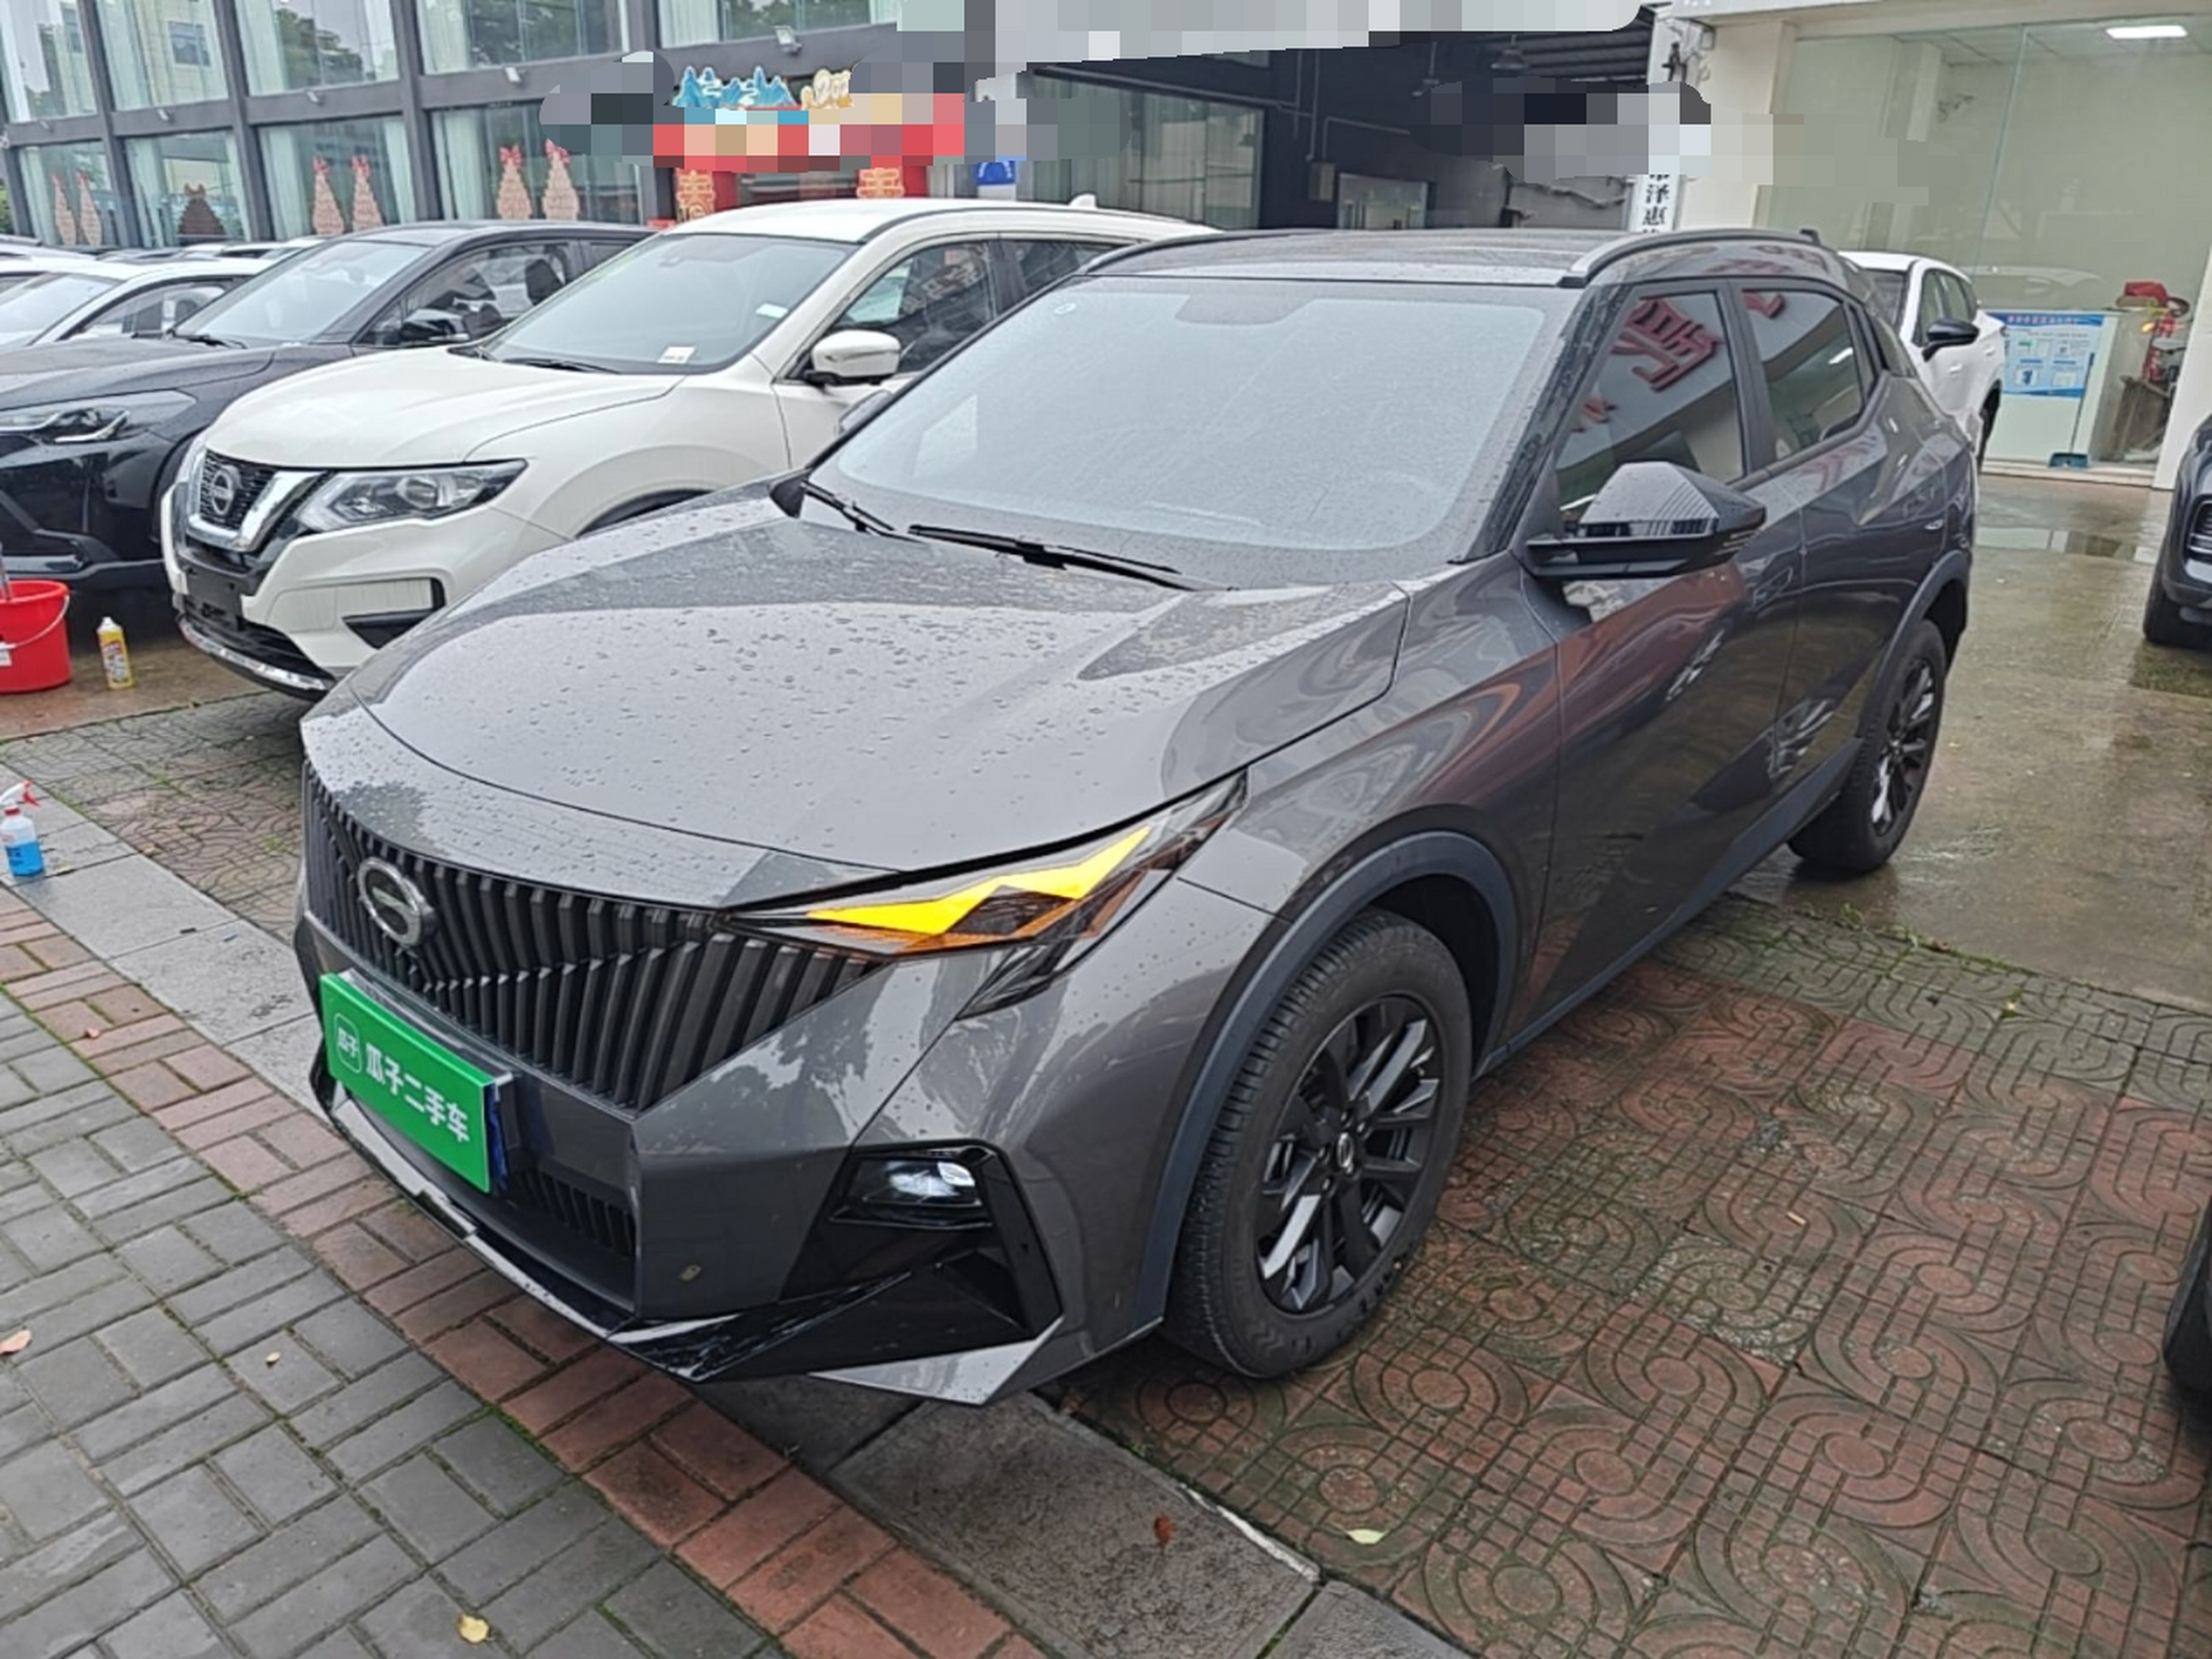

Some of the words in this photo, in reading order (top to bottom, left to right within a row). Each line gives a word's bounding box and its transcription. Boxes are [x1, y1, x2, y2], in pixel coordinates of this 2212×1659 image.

[1642, 174, 1671, 233] 泽惠
[366, 1042, 470, 1142] 瓜子二手车
